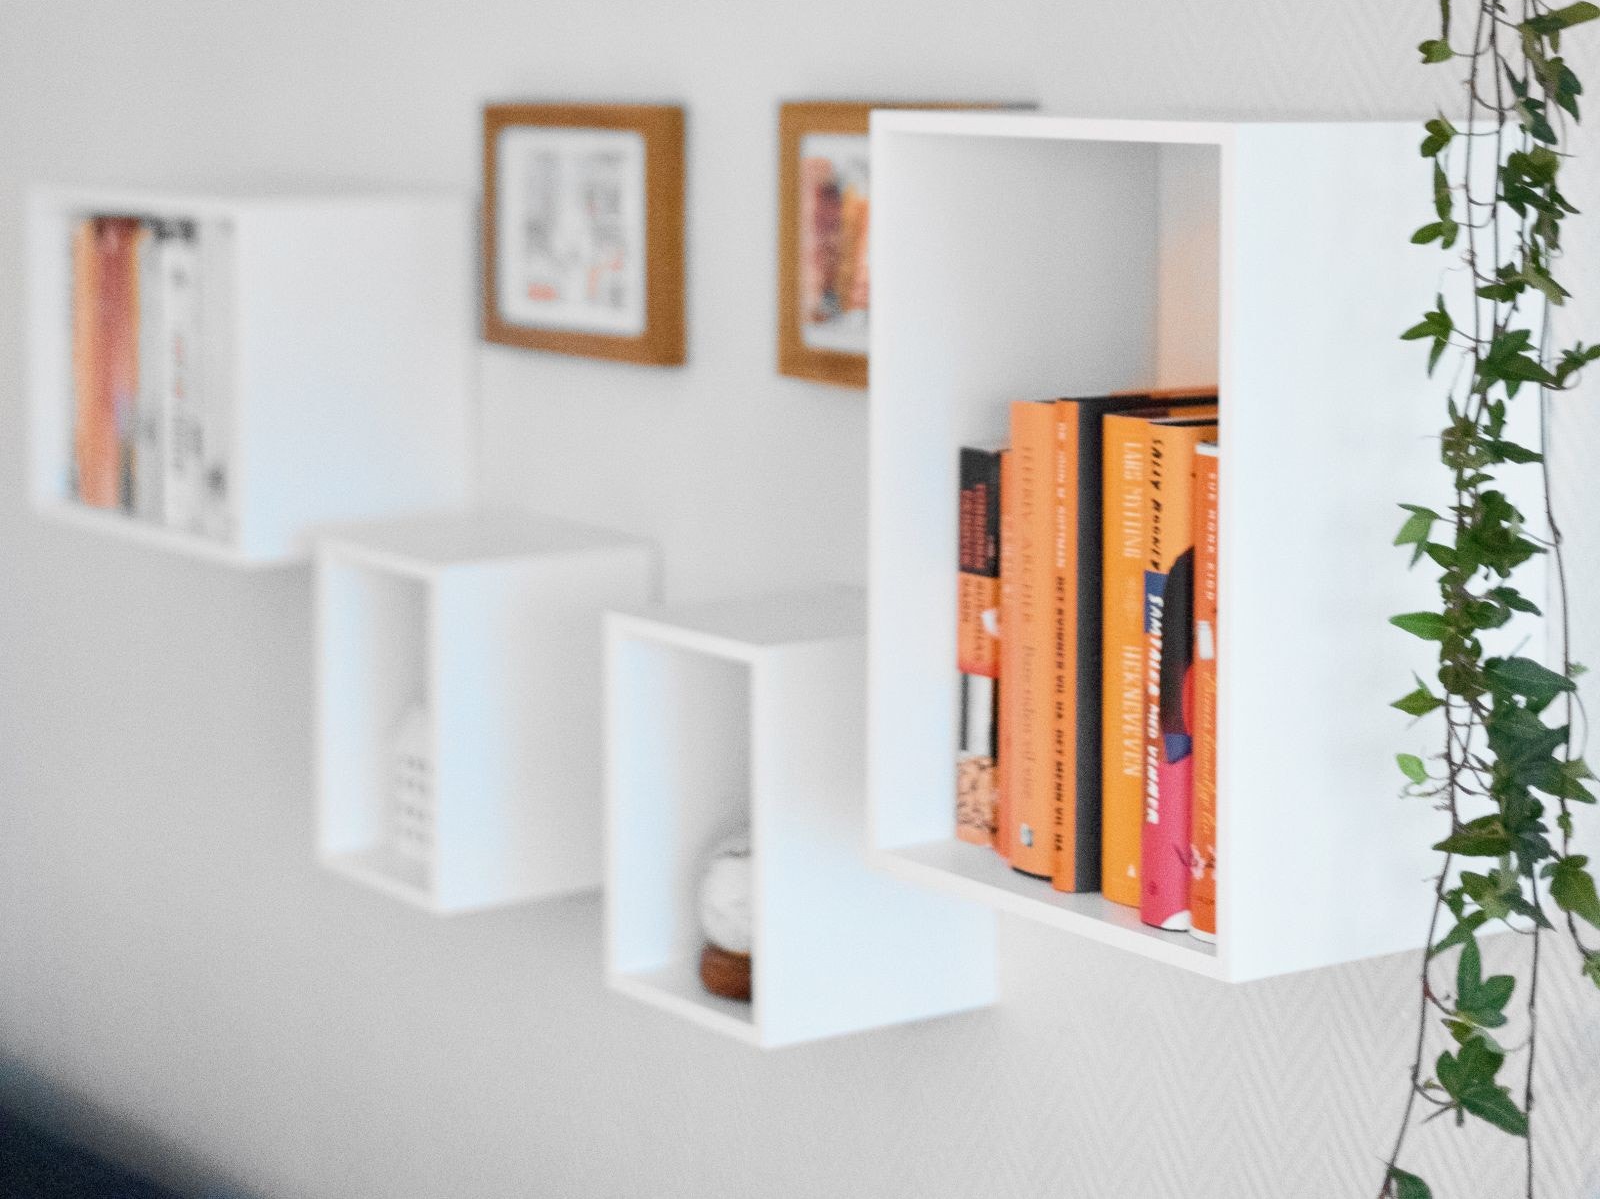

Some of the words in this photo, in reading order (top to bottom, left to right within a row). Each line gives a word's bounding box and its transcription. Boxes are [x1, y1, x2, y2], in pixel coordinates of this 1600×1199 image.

[1121, 440, 1144, 481] LARS
[1149, 438, 1164, 491] SALLY
[1206, 471, 1218, 501] SUE
[1121, 485, 1144, 558] MYTTING
[1149, 497, 1163, 569] ROONEY
[1205, 509, 1217, 553] MONK
[1020, 535, 1036, 624] ARCHER
[1146, 593, 1166, 697] SAMTALER
[1121, 643, 1144, 777] HEKNEVEVEN
[1146, 703, 1161, 738] MED
[1145, 743, 1160, 825] VENNER
